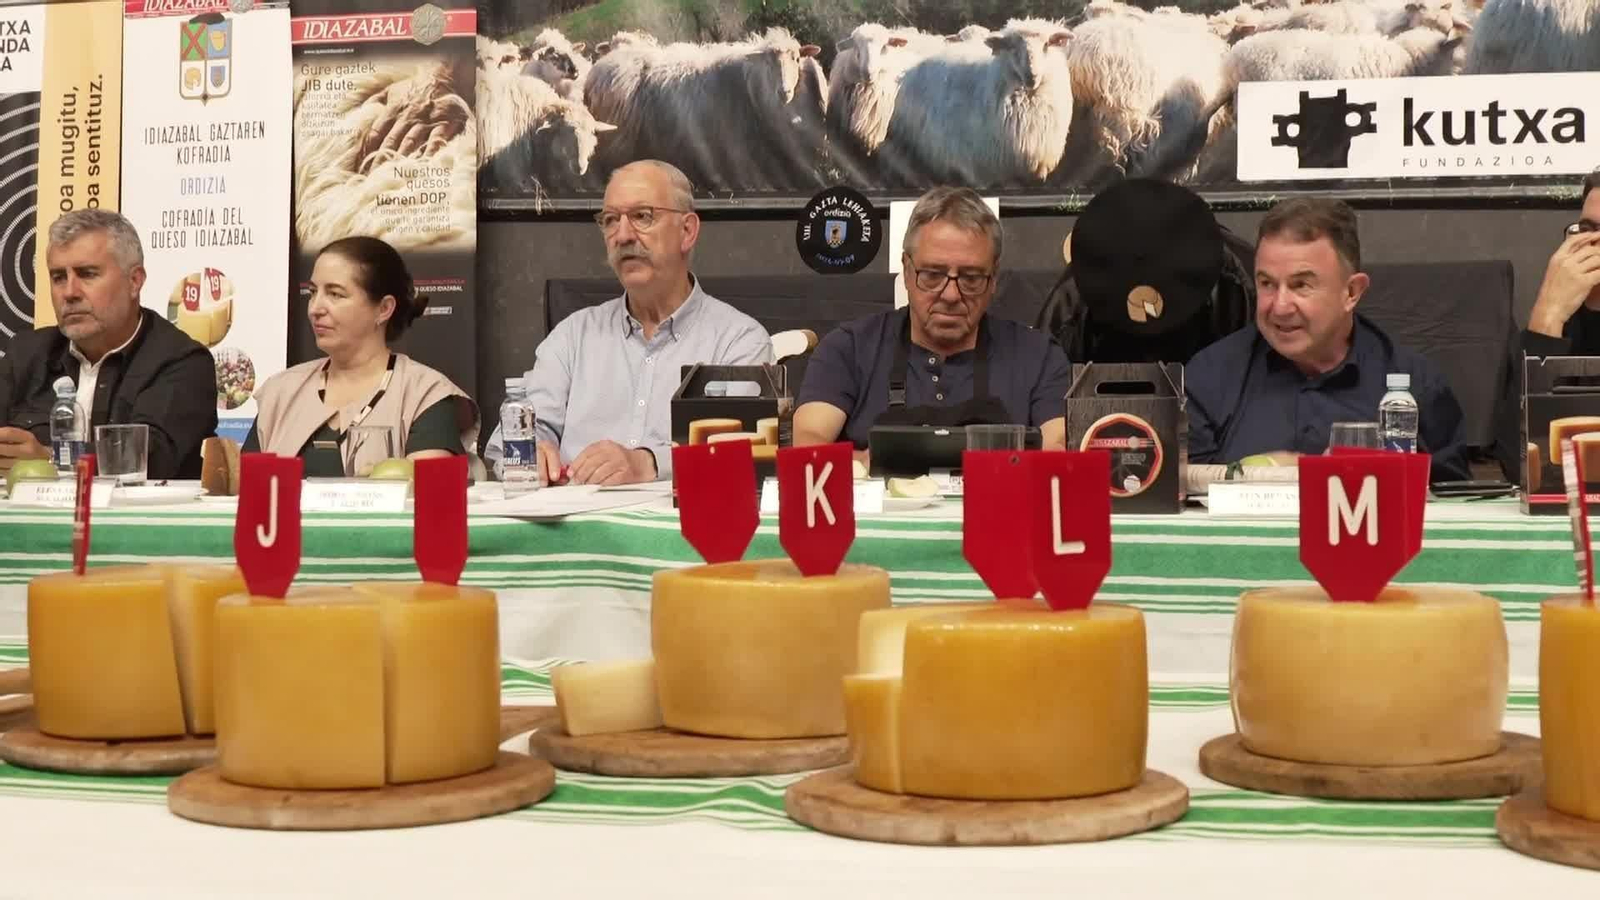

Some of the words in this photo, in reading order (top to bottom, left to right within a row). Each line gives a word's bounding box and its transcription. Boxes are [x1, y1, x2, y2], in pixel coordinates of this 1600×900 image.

[303, 18, 408, 40] IDIAZABAL
[301, 63, 332, 76] Gure
[336, 61, 377, 78] gaztek
[301, 79, 321, 92] JIB
[325, 78, 357, 91] dute.
[57, 86, 80, 177] mugitu,
[84, 74, 103, 176] sentituz.
[144, 127, 202, 145] IDIAZABAL
[209, 121, 265, 143] GAZTAREN
[1403, 98, 1586, 147] kutxa
[176, 145, 231, 165] KOFRADIA
[1403, 156, 1553, 168] FUNDAZIOA
[394, 166, 450, 178] Nuestros
[180, 177, 226, 196] ORDIZIA
[406, 179, 450, 191] quesos
[376, 194, 416, 207] tienen
[809, 195, 838, 218] GAZTA
[162, 207, 215, 228] COFRADÍA
[223, 207, 243, 226] DEL
[824, 208, 851, 218] ordizia
[151, 230, 187, 249] QUESO
[195, 227, 254, 247] IDIAZABAL
[210, 274, 220, 291] 19
[185, 285, 198, 302] 19
[805, 461, 836, 528] K
[256, 474, 278, 548] J
[1051, 475, 1086, 555] L
[1327, 474, 1378, 546] M
